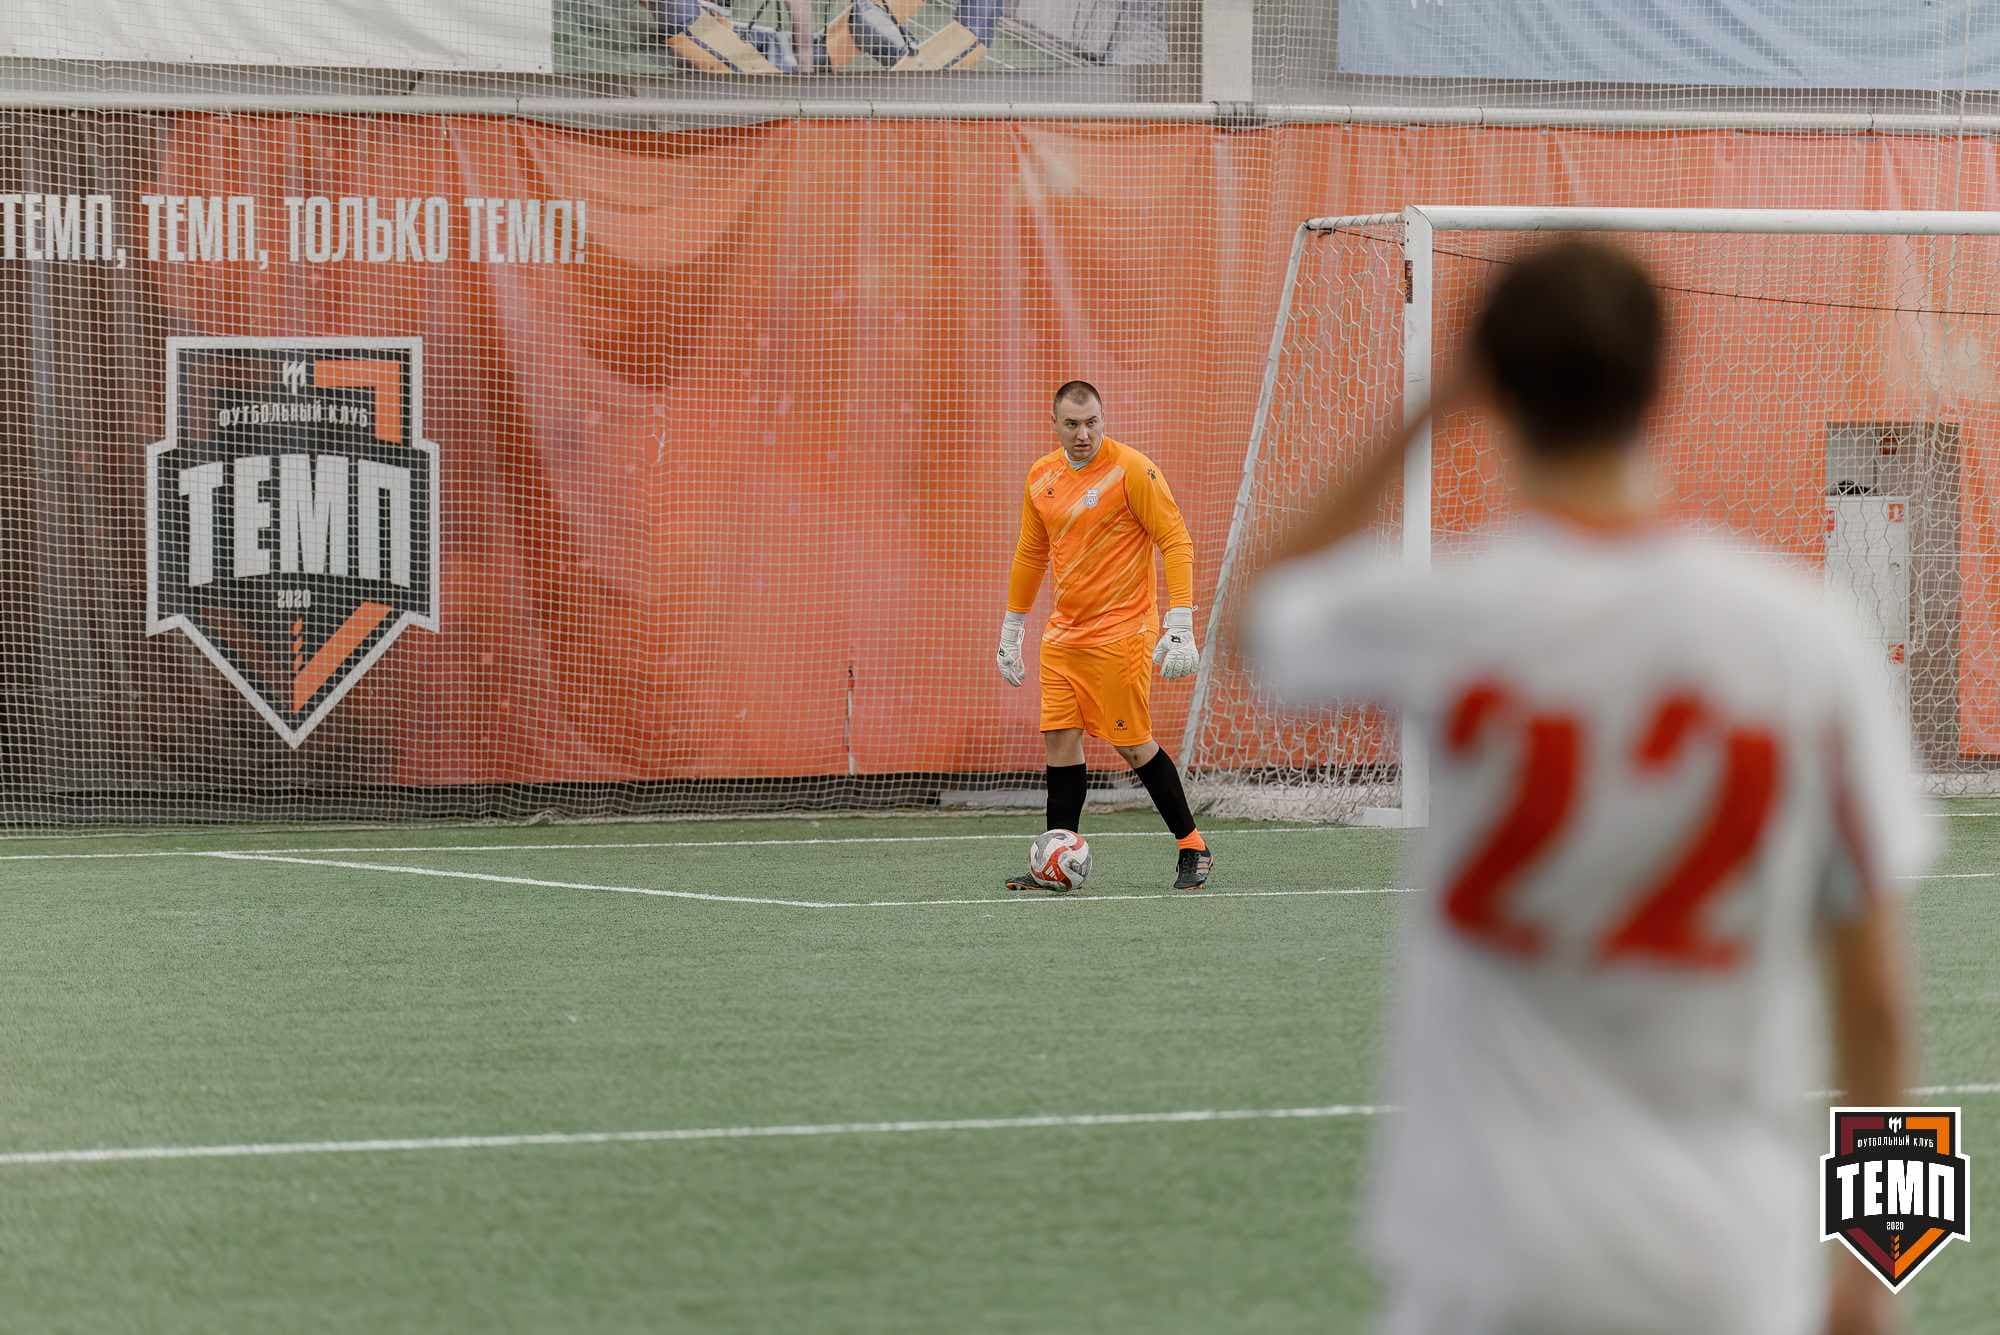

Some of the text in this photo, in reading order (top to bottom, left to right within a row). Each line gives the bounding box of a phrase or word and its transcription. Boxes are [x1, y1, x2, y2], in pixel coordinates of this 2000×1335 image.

[0, 194, 587, 270] ТЕМП, ТЕМП, ТОЛЬКО ТЕМП!
[219, 400, 369, 428] ФУТБОЛЬНЫЙ КЛУБ
[179, 453, 411, 589] ТЕМП
[277, 589, 311, 608] 2020
[1442, 680, 1784, 968] 22
